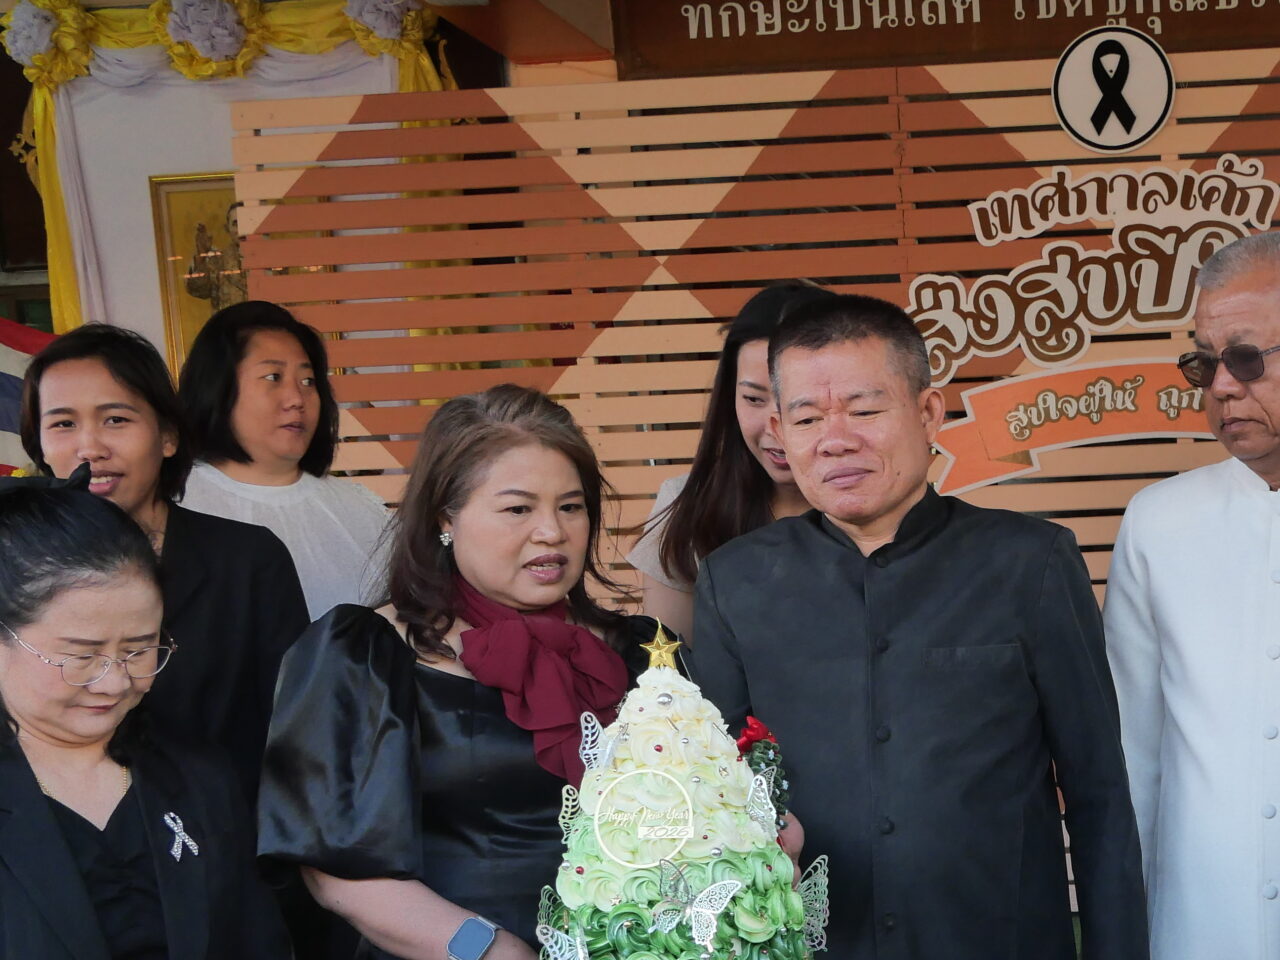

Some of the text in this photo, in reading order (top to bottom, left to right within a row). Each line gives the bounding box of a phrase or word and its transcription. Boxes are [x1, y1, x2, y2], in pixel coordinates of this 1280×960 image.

[975, 158, 1275, 242] เทศกาลเค้ก
[1004, 374, 1208, 441] สุขใจผู้ให้ ถูก
[597, 806, 690, 828] Happy New Year
[643, 826, 690, 838] 2026
